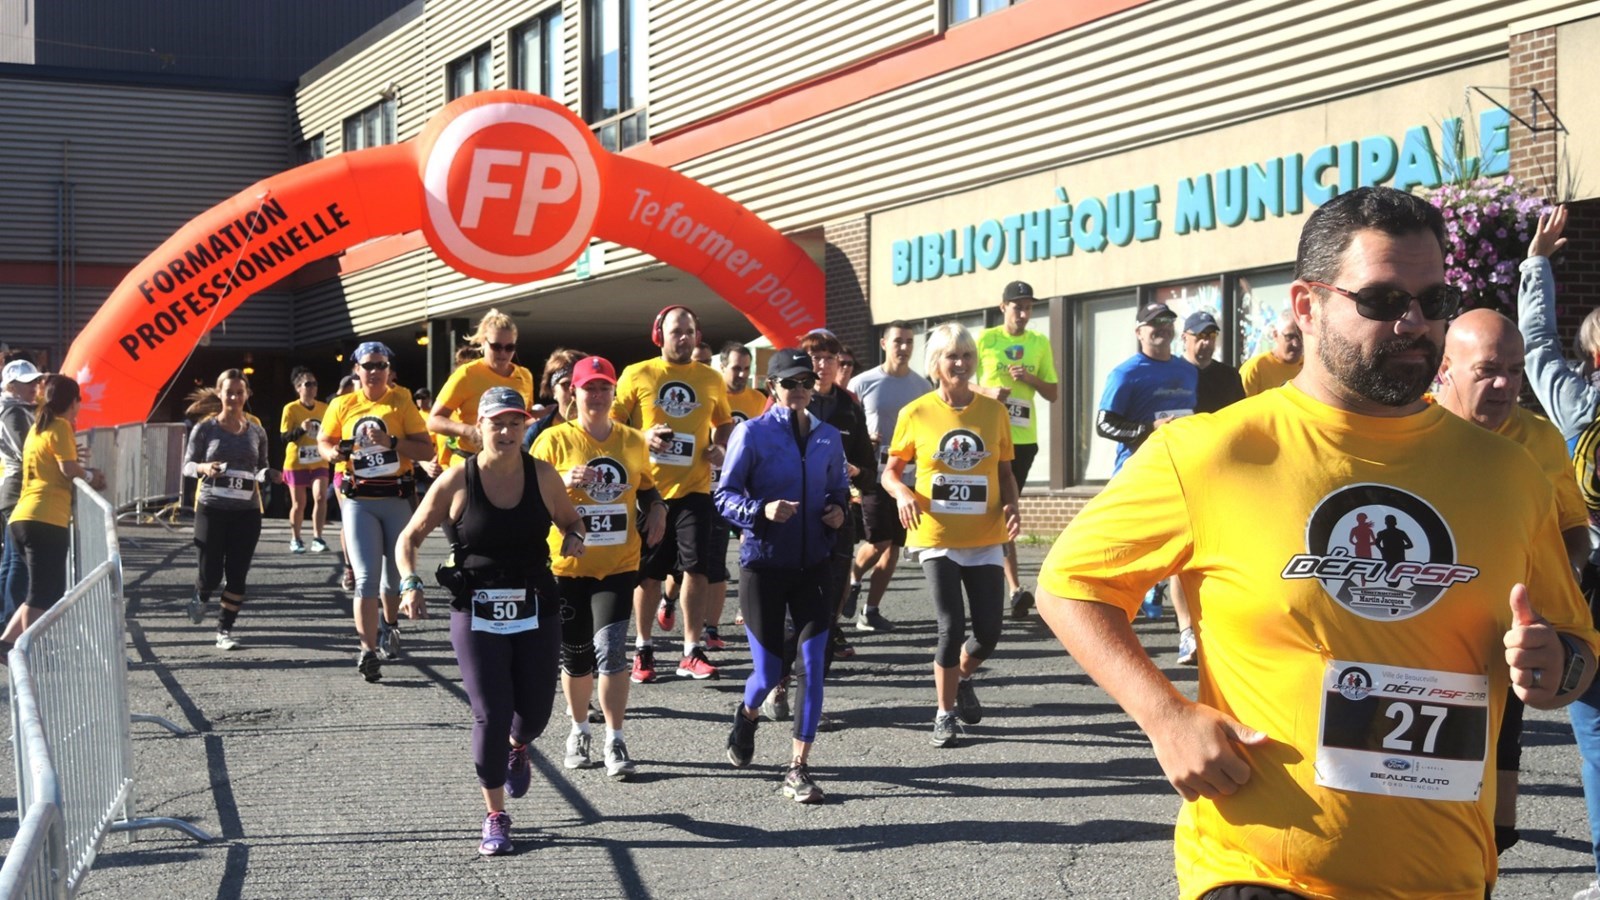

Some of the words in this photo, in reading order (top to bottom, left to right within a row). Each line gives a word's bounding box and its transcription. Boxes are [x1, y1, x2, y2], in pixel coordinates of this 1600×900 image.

[460, 148, 578, 236] FP
[891, 186, 1161, 286] BIBLIOTHÈQUE
[1174, 107, 1510, 235] MUNICIPALE
[138, 198, 288, 304] FORMATION
[629, 188, 658, 227] Te
[656, 201, 762, 279] former
[746, 273, 815, 330] pour
[118, 202, 350, 361] PROFESSIONNELLE
[1008, 405, 1022, 417] 45
[367, 453, 384, 467] 36
[228, 478, 243, 489] 18
[948, 485, 970, 500] 20
[590, 515, 612, 531] 54
[1283, 547, 1384, 581] DÉFI
[1387, 562, 1477, 586] PSF
[493, 602, 517, 619] 50
[1382, 671, 1396, 679] Ville
[1396, 672, 1404, 680] de
[1404, 673, 1439, 684] Beauceville
[1383, 681, 1426, 694] DÉFI
[1428, 688, 1466, 699] PSF
[1382, 702, 1448, 753] 27
[1370, 772, 1418, 783] BEAUCE
[1419, 777, 1450, 785] AUTO
